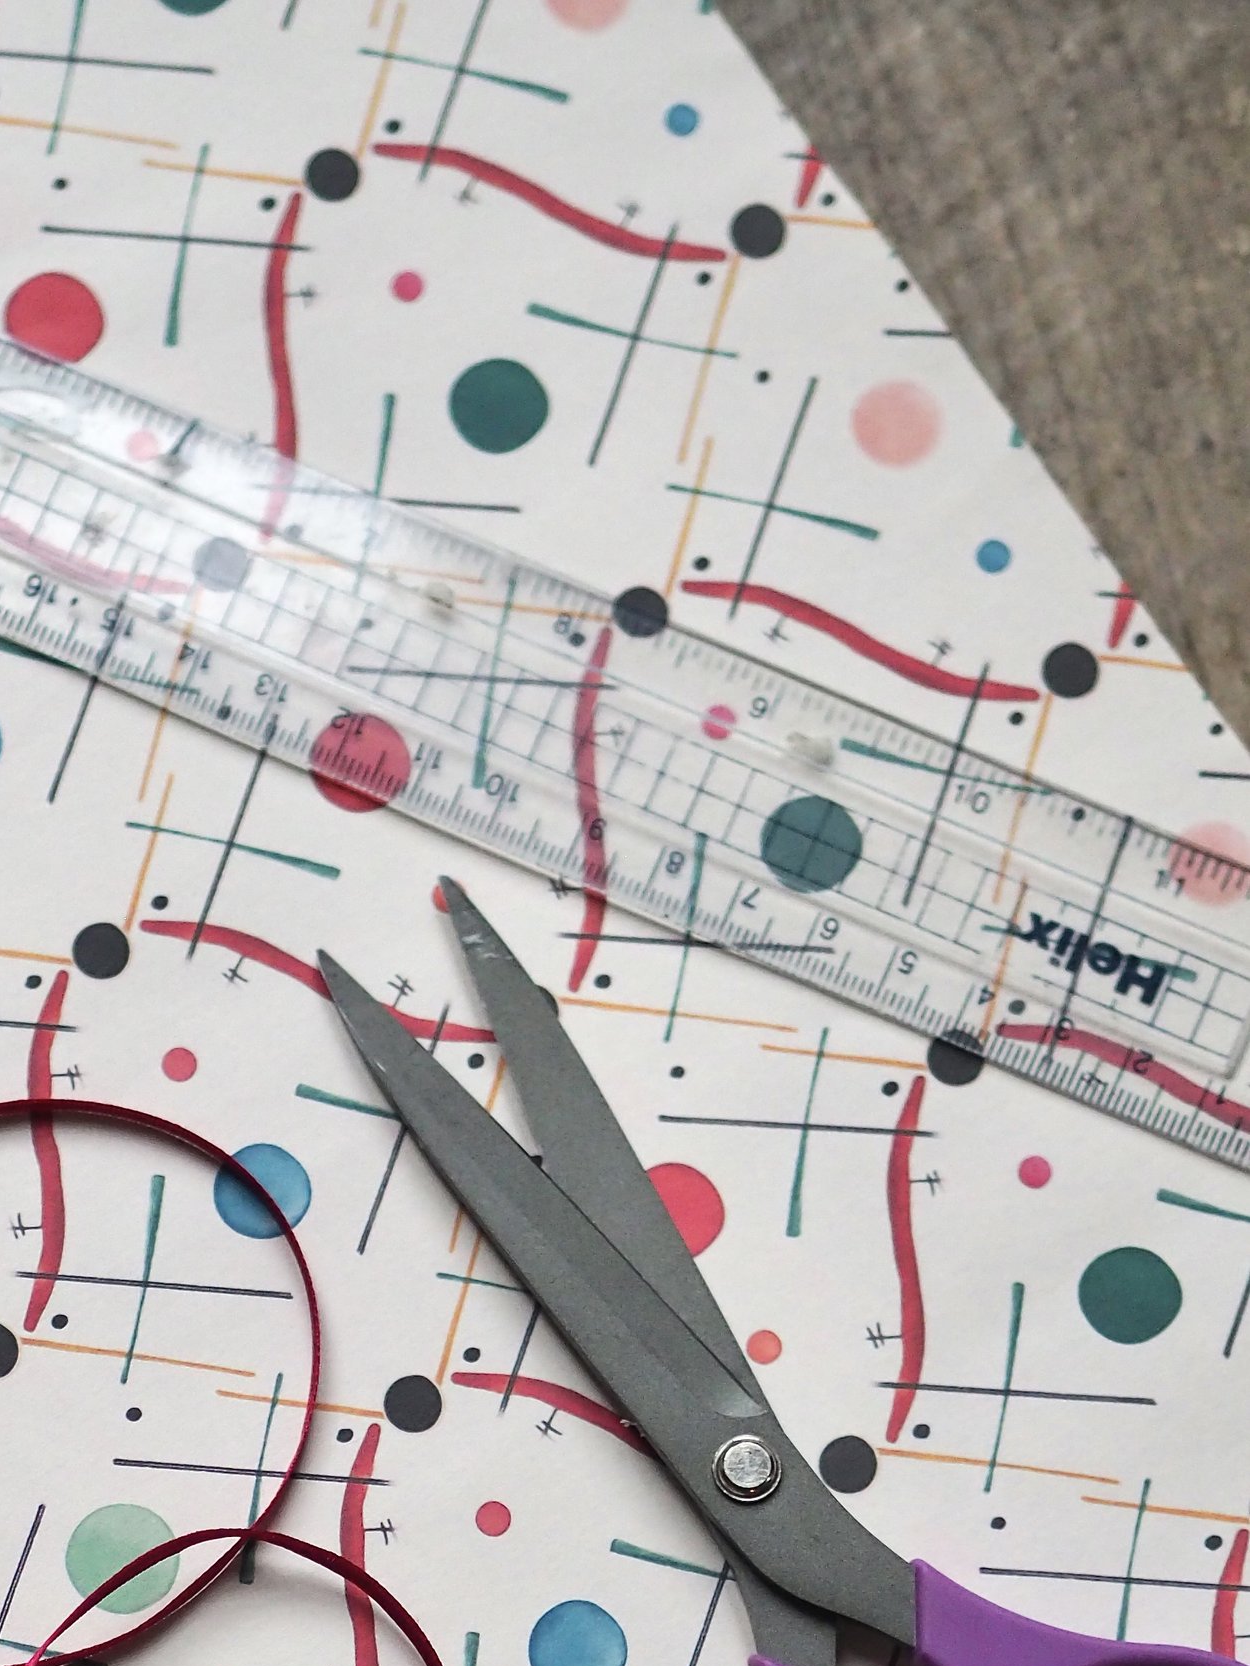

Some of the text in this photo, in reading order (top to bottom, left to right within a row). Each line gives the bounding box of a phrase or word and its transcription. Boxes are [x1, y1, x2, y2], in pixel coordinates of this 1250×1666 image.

[23, 574, 56, 605] 16
[101, 607, 134, 637] 15
[178, 641, 210, 669] 14
[254, 673, 288, 702] 13
[330, 706, 367, 735] 12
[414, 741, 442, 770] 11
[485, 773, 520, 803] 10
[749, 697, 769, 719] 9
[954, 783, 990, 813] 10
[1155, 868, 1186, 897] 11
[590, 818, 607, 841] 9
[665, 851, 685, 874] 8
[741, 887, 760, 910] 7
[820, 917, 840, 940] 6
[897, 951, 919, 975] 5
[1015, 912, 1168, 1006] Helix
[977, 984, 996, 1006] 4
[1055, 1017, 1075, 1041] 3
[1132, 1050, 1154, 1075] 2
[1216, 1085, 1227, 1105] 1
